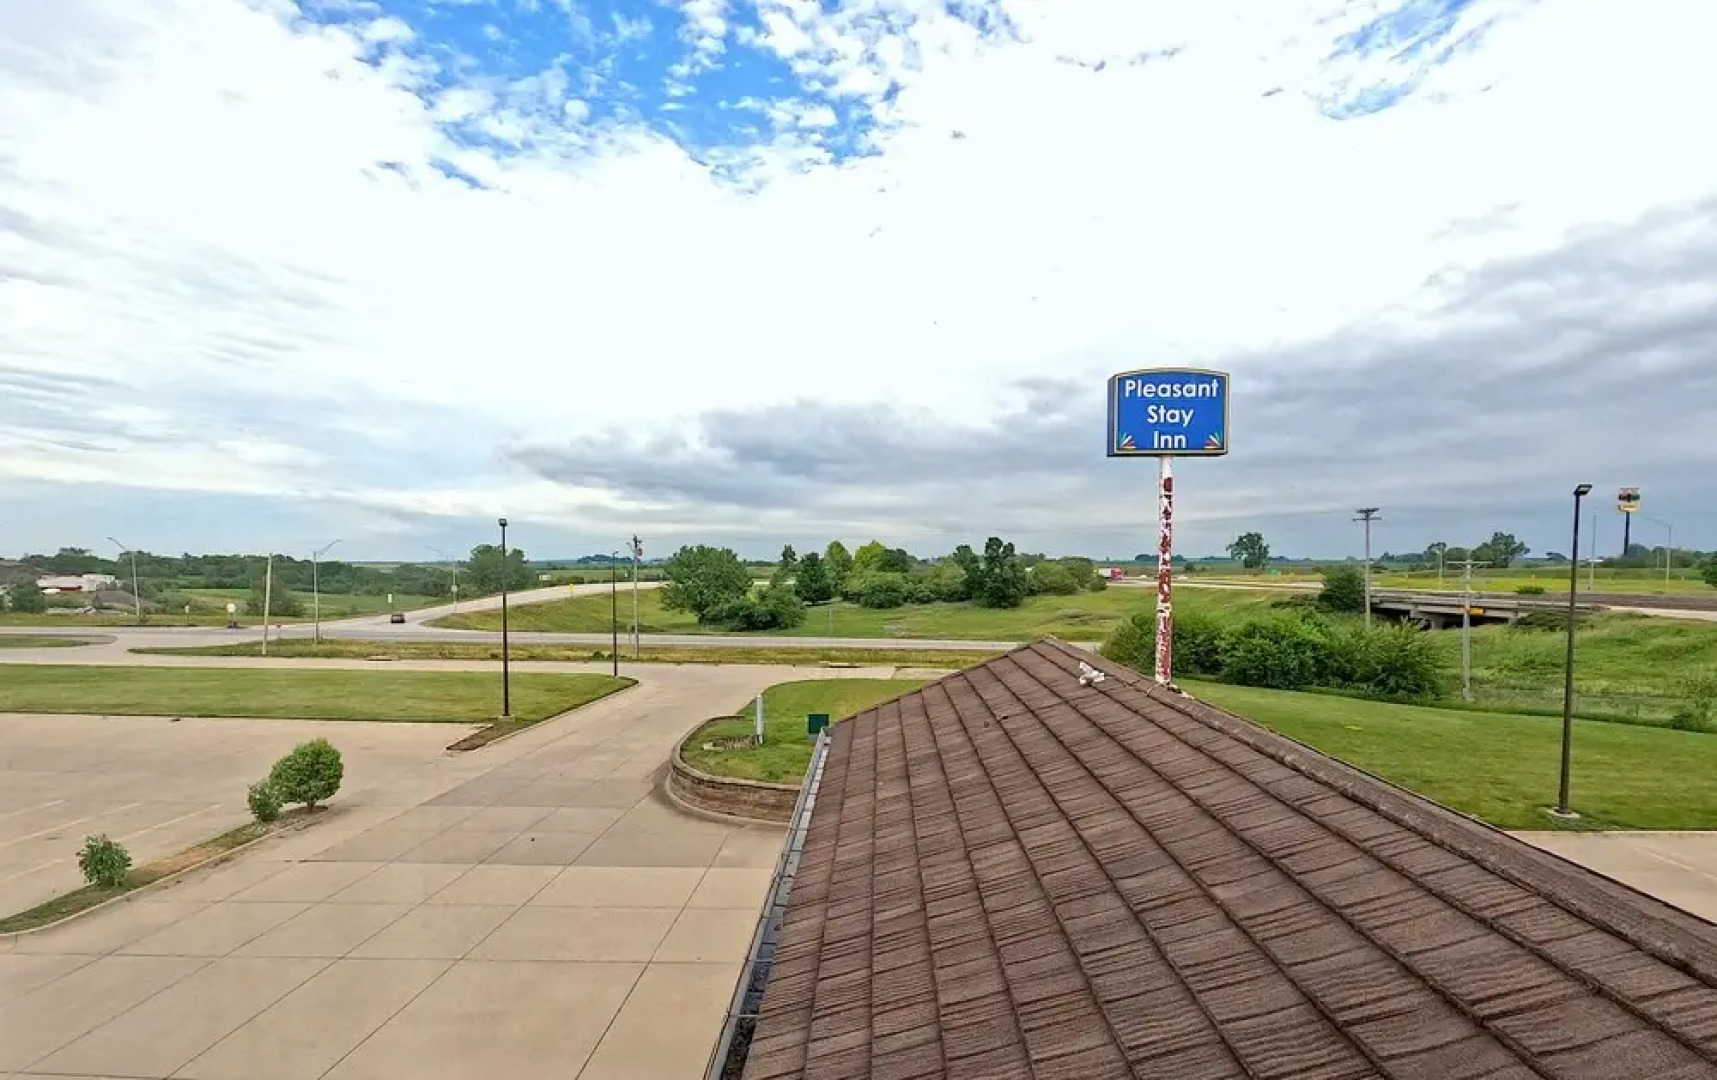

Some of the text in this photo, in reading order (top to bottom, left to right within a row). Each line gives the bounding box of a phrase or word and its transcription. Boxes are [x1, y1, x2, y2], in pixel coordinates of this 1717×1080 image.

[1124, 379, 1219, 397] Pleasant
[1147, 404, 1194, 427] Stay
[1153, 430, 1187, 449] Inn
